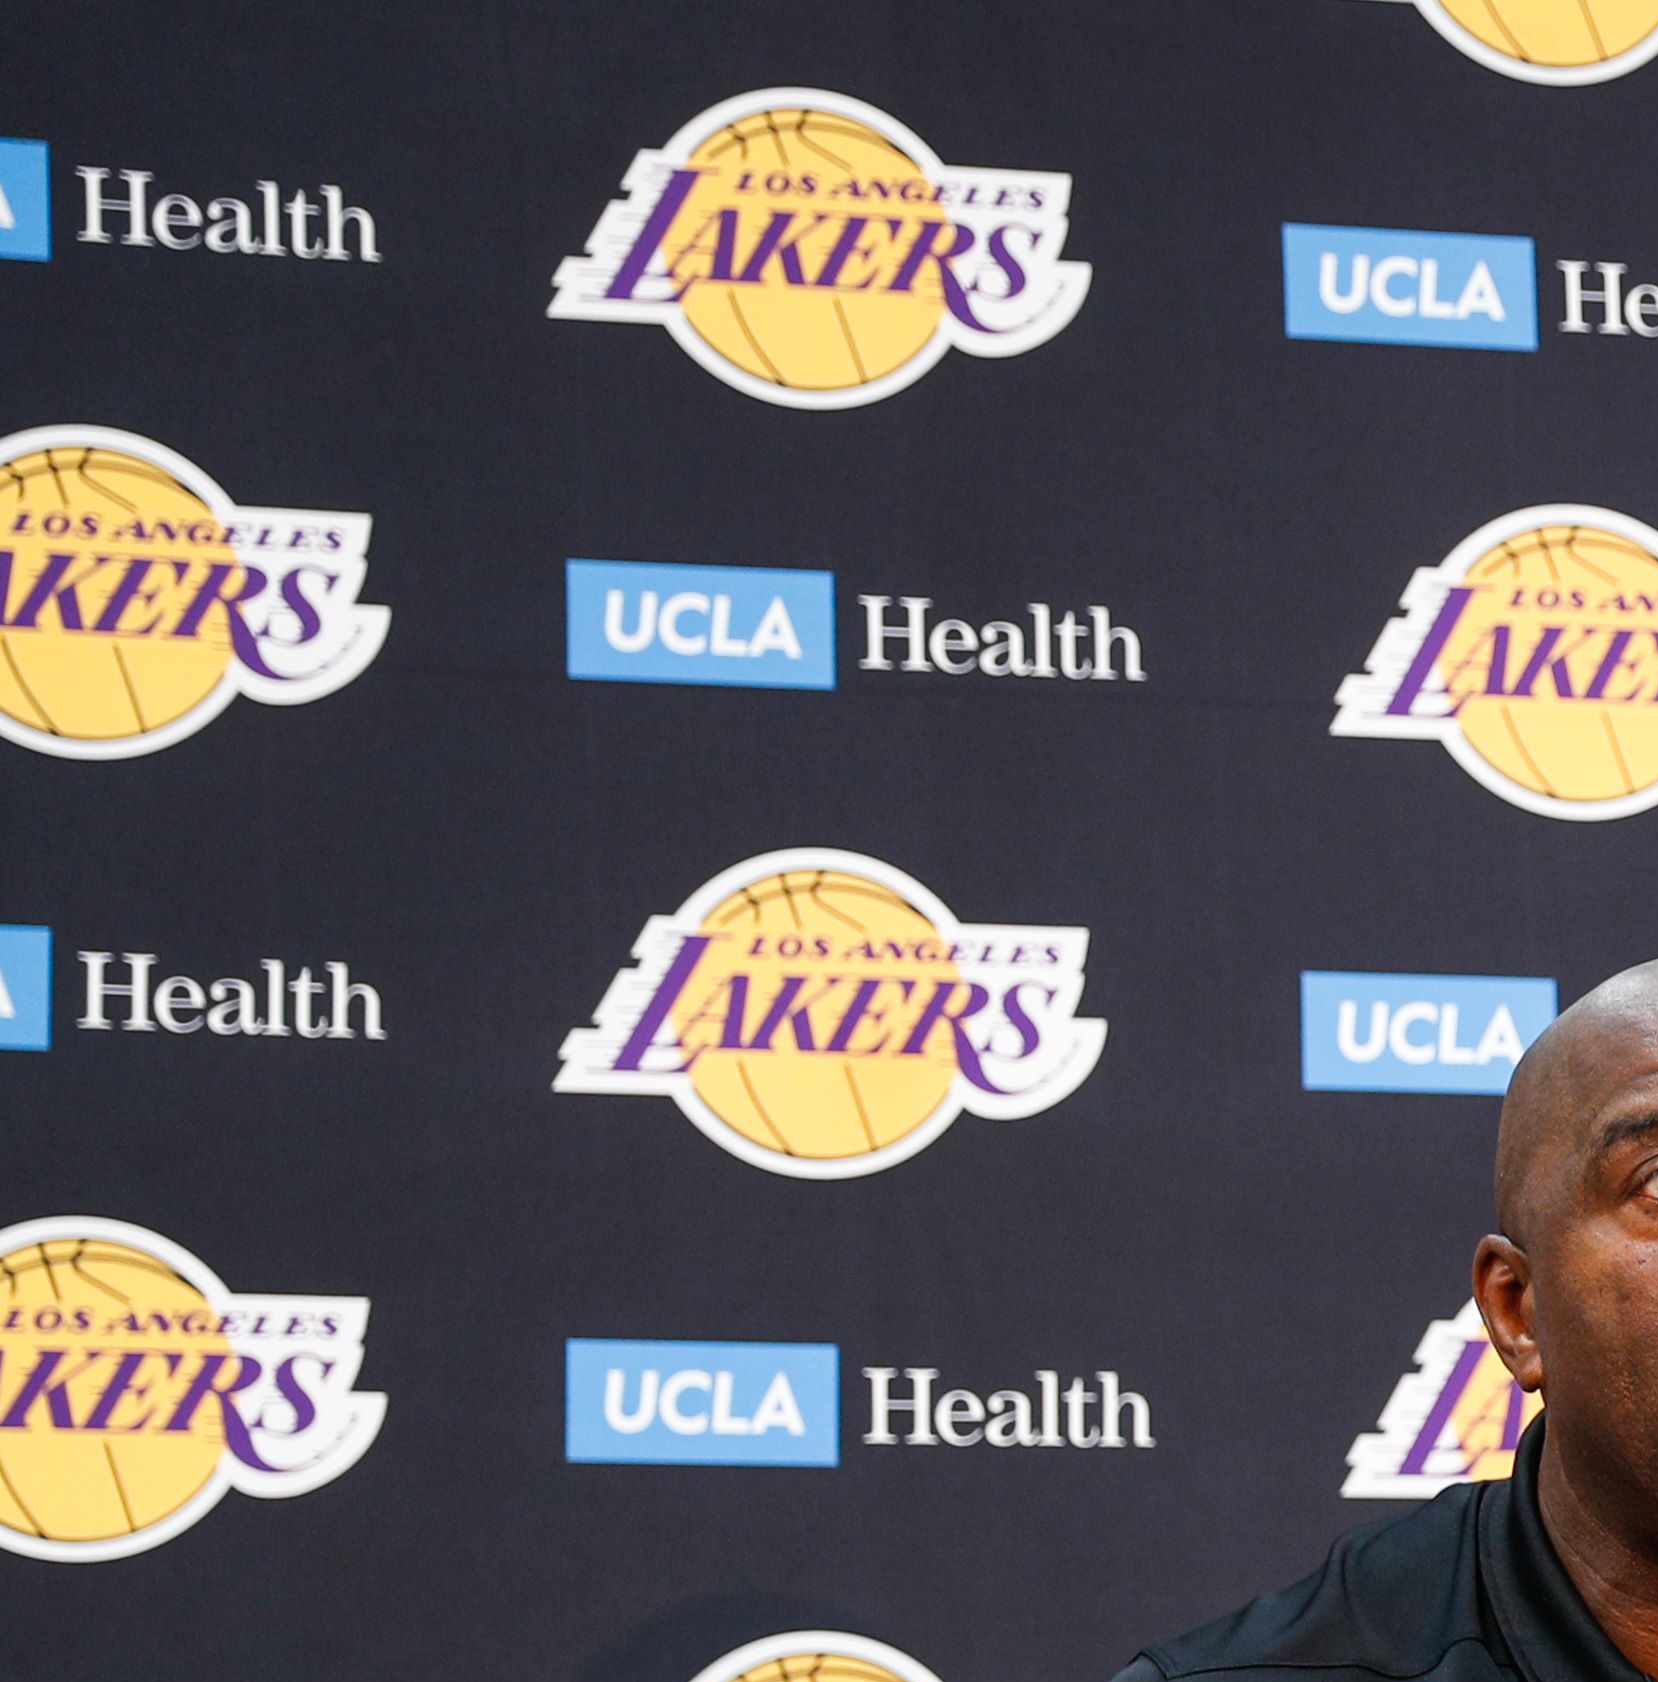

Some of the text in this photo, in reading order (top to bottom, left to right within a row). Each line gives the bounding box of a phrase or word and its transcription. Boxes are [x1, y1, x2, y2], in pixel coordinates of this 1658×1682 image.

[76, 165, 383, 262] Health
[736, 173, 1045, 208] LOS ANGELES
[604, 169, 1045, 333] LAKERS
[1318, 251, 1508, 322] UCLA
[12, 513, 343, 550] LOS ANGELES
[0, 550, 341, 680] KERS
[603, 588, 1145, 682] UCLA Health
[1509, 588, 1584, 608] LOS
[748, 936, 1061, 964] LOS ANGELES
[78, 951, 386, 1040] Health
[611, 934, 1060, 1095] LAKERS
[1335, 998, 1523, 1069] UCLA
[3, 1308, 340, 1335] LOS ANGELES
[0, 1350, 338, 1473] KERS
[603, 1367, 1153, 1449] UCLA Health
